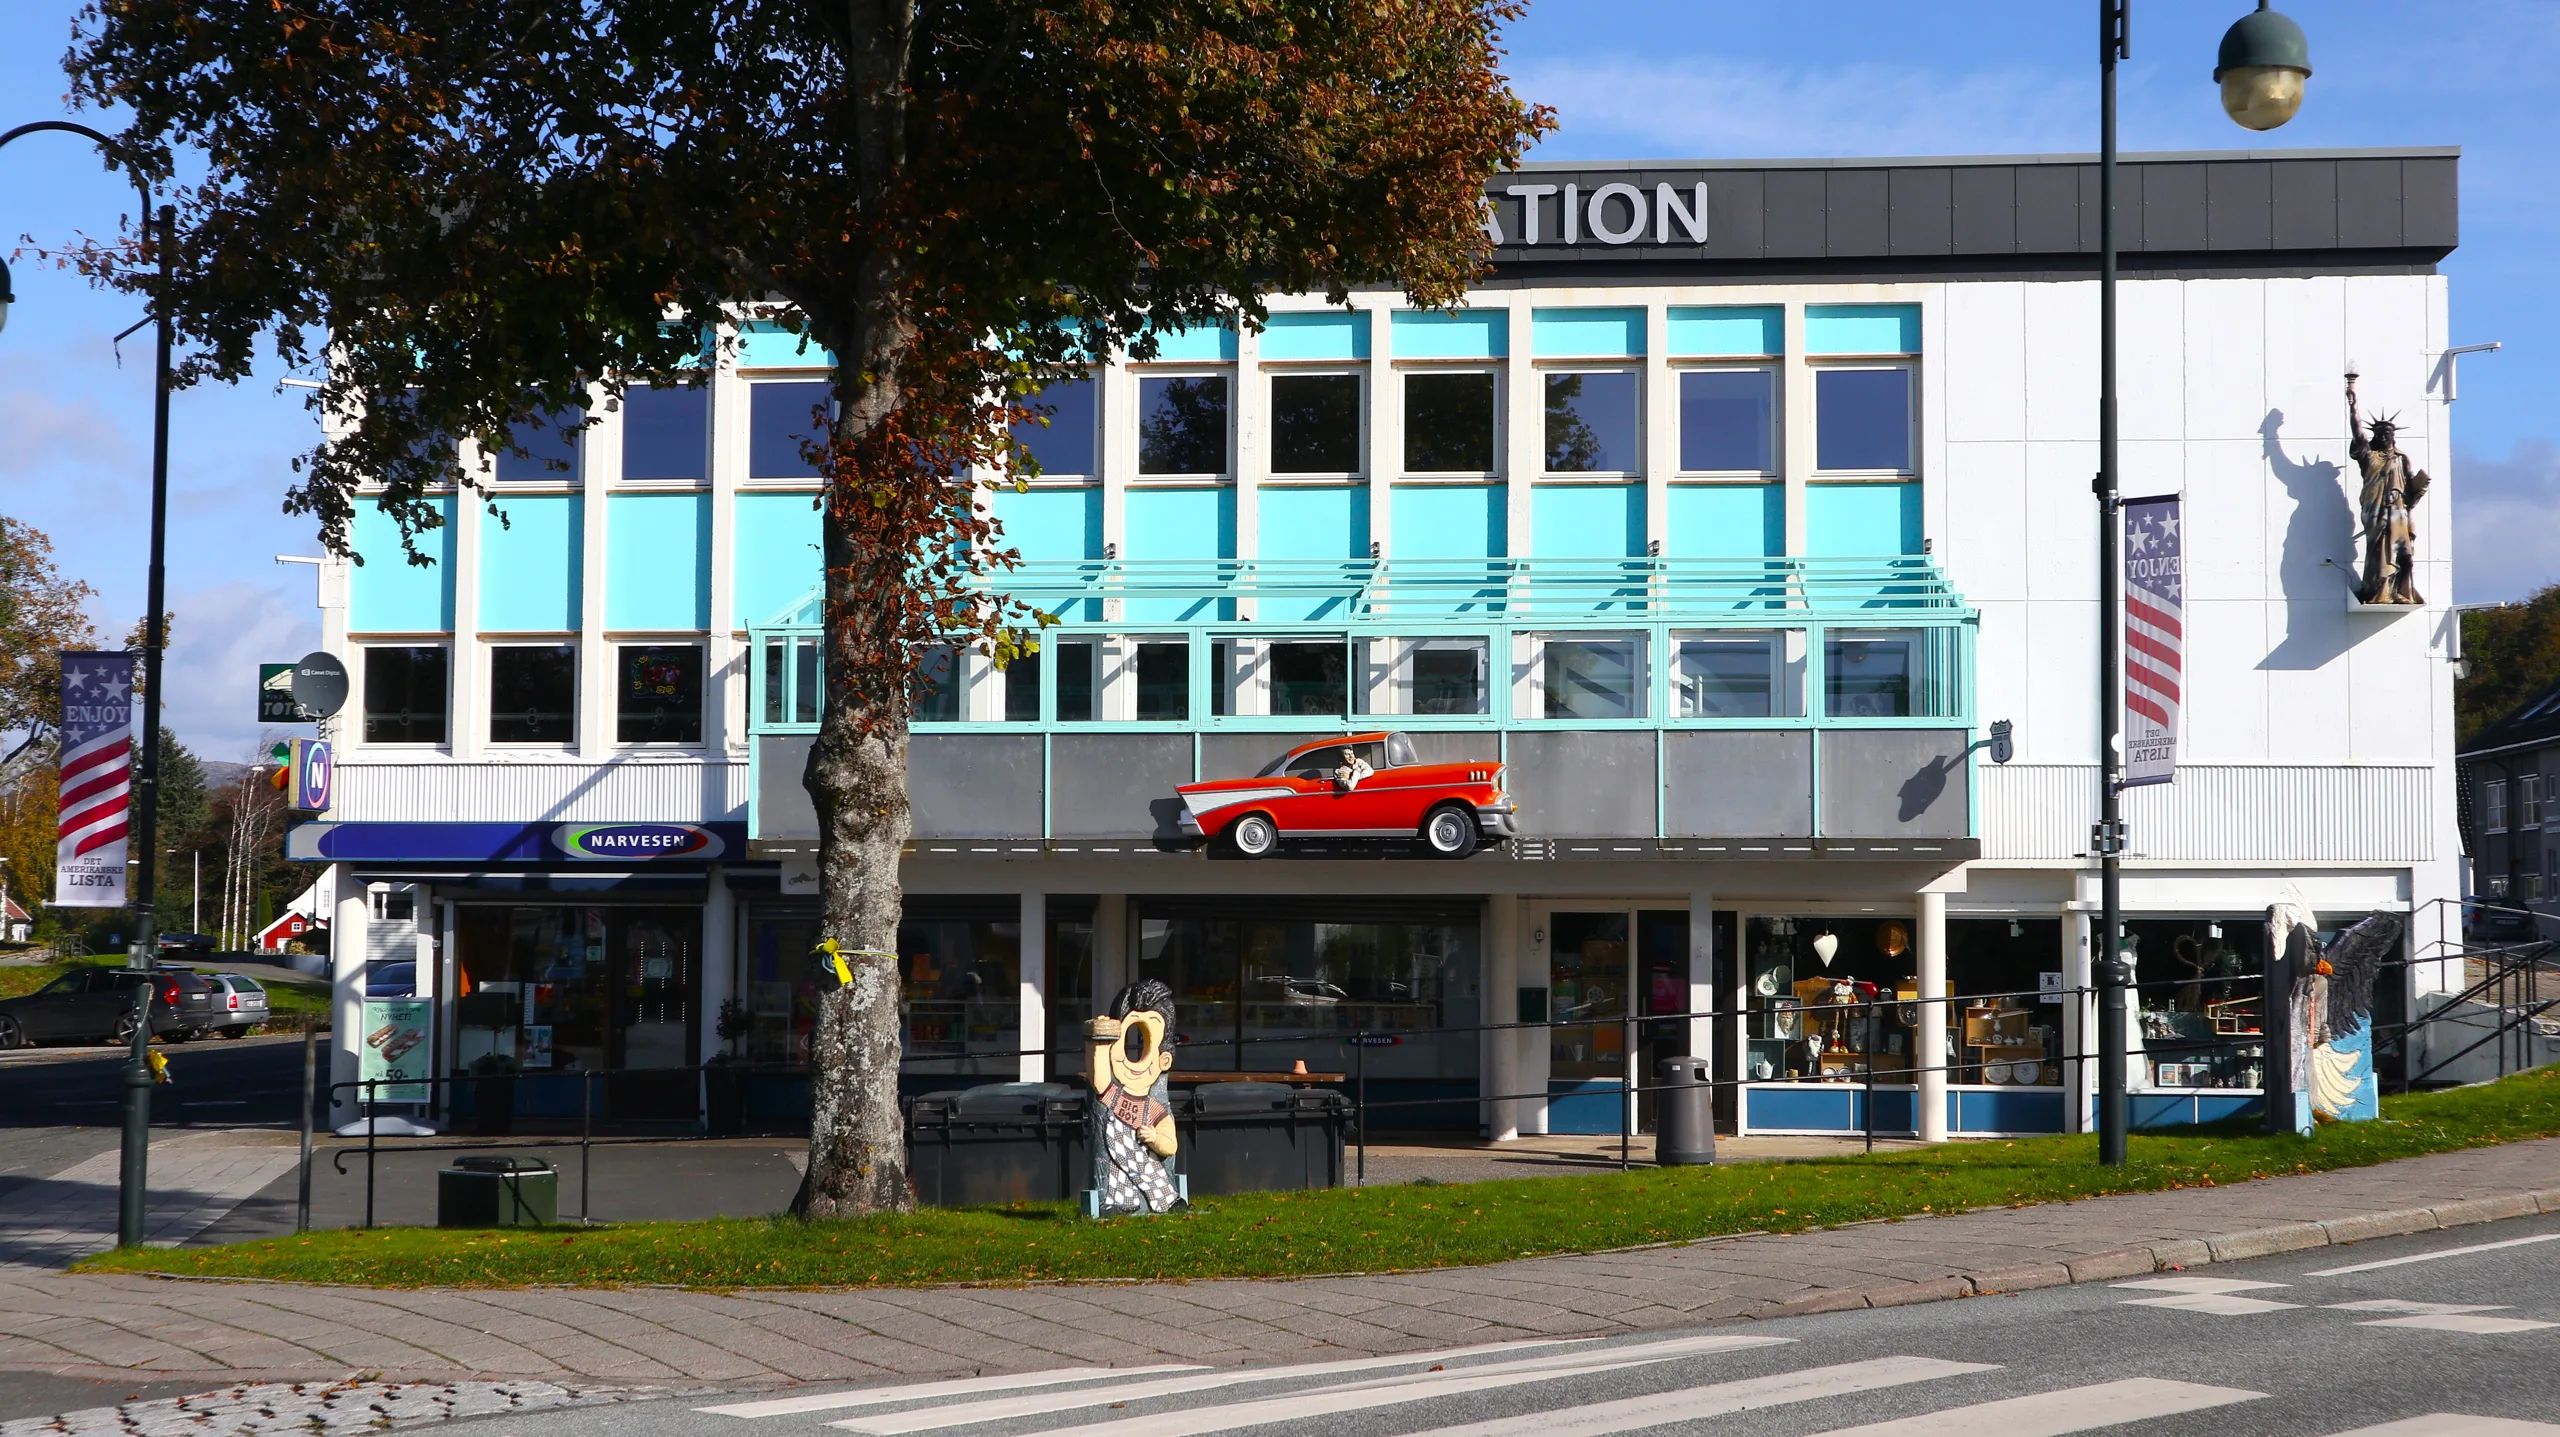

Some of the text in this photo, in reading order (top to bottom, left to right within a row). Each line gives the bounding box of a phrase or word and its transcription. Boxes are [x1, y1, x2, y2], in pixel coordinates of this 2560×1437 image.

[325, 669, 341, 677] Digital
[66, 705, 130, 723] ENJOY
[263, 702, 301, 717] TOT
[1998, 742, 2004, 758] 8
[311, 762, 324, 789] N
[591, 835, 684, 847] NARVESEN
[83, 858, 103, 866] DET
[60, 865, 124, 874] AMERIKANSKE
[69, 875, 115, 887] LISTA
[380, 1013, 412, 1021] NYHET!
[1121, 1100, 1138, 1114] BIG
[1118, 1109, 1137, 1124] BOY
